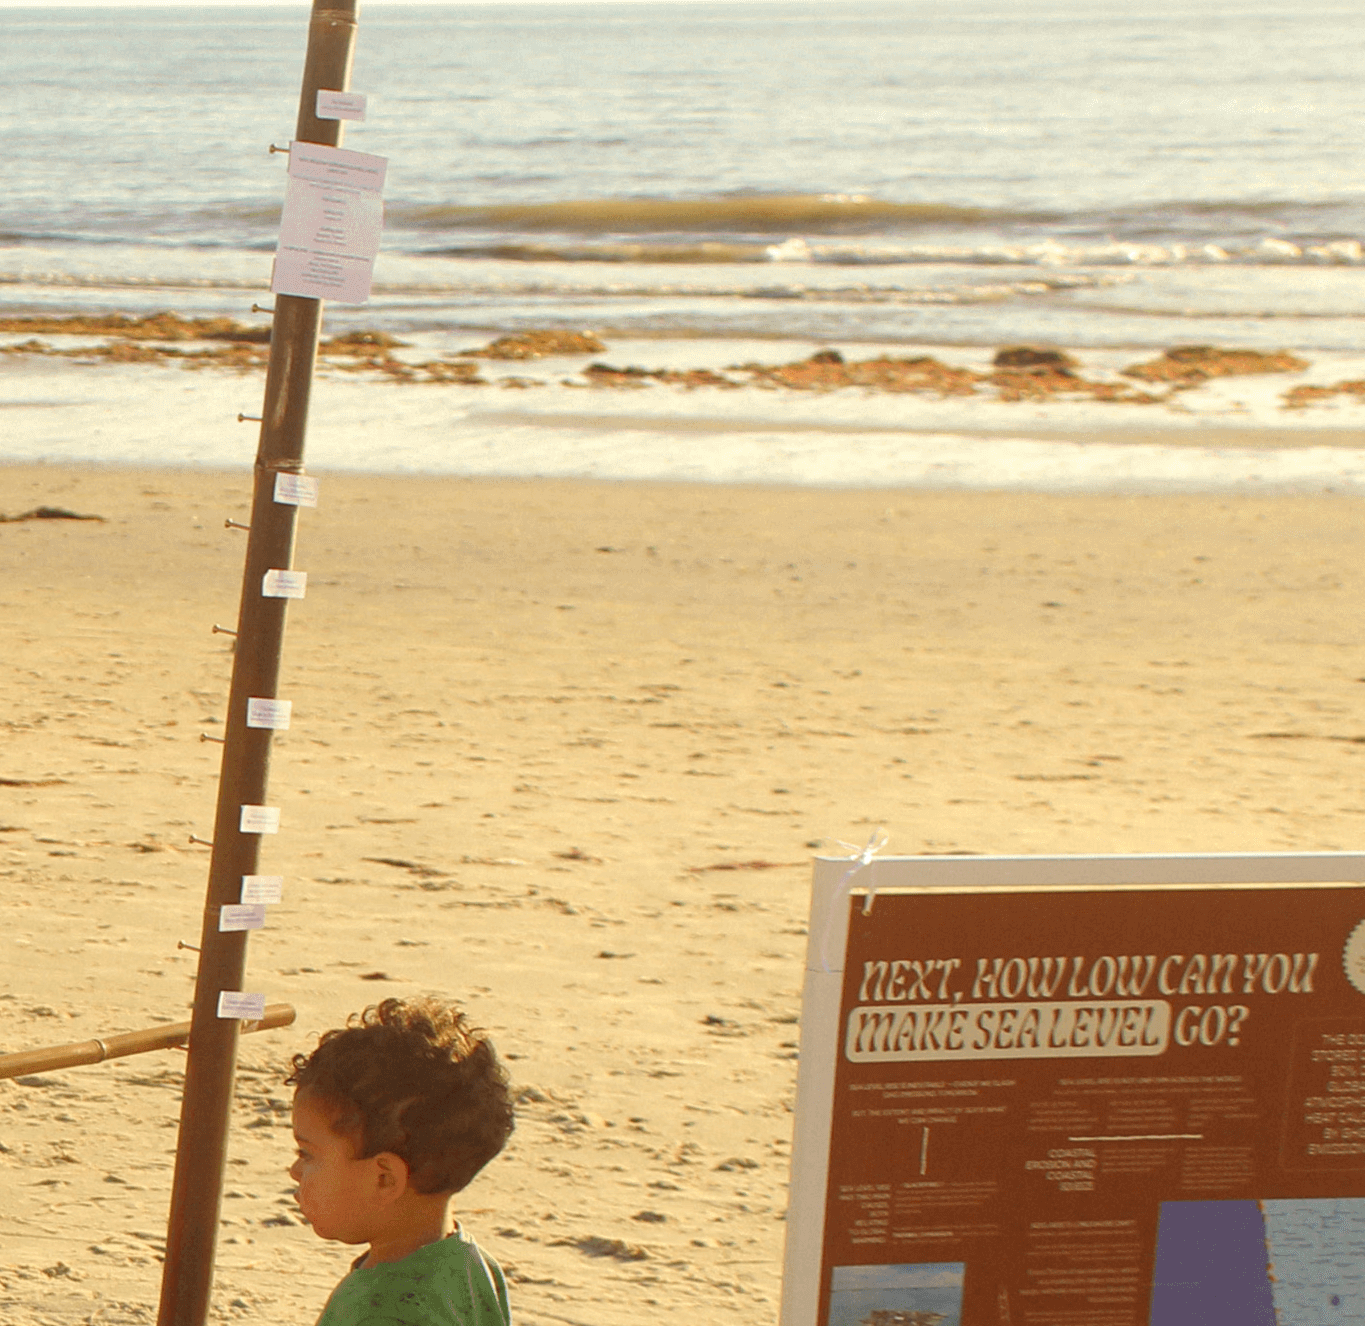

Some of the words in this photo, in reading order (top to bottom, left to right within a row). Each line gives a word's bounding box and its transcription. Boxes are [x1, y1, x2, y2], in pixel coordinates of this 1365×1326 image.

[858, 958, 964, 1007] NEXT,
[972, 957, 1067, 998] HOW
[1068, 955, 1158, 997] LOW
[1157, 953, 1239, 995] CAN
[1242, 952, 1319, 994] YOU
[854, 1010, 970, 1053] MAKE
[971, 1008, 1041, 1050] SEA
[1047, 1006, 1160, 1048] LEVEL
[1173, 1005, 1251, 1046] GO?
